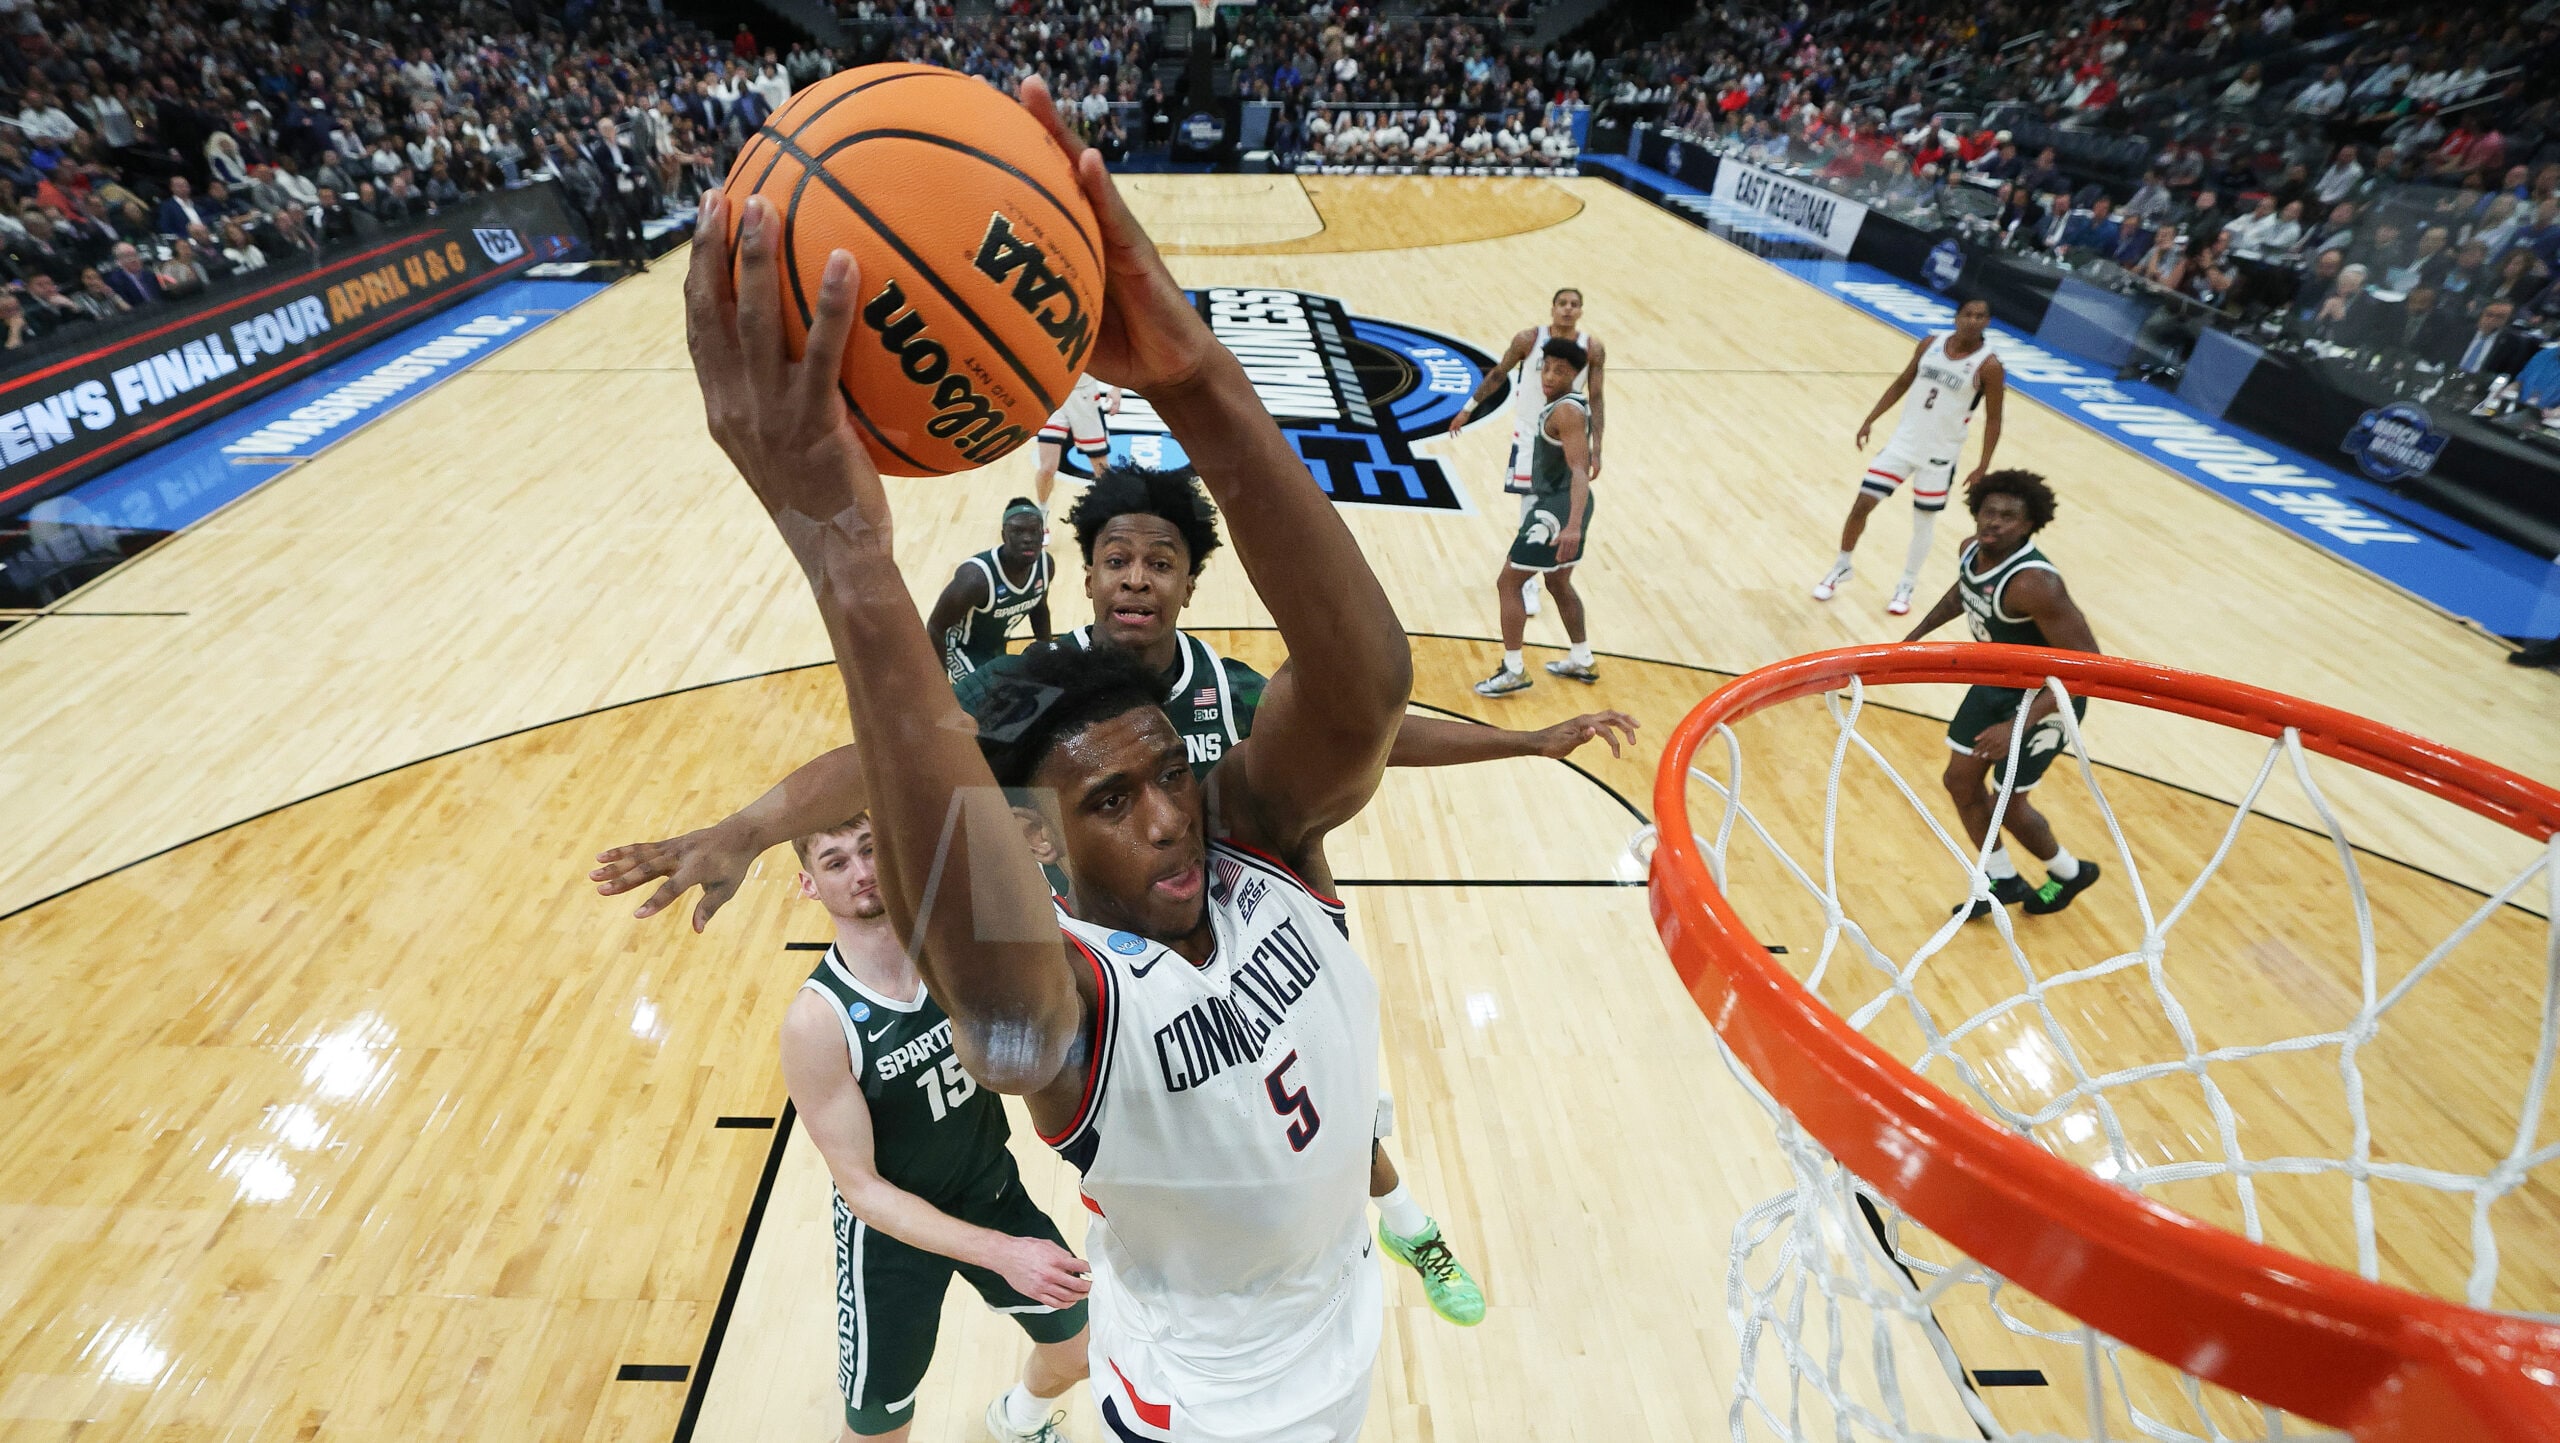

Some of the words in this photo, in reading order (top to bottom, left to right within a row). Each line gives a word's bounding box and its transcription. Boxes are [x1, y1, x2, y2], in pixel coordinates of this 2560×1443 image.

[1736, 172, 1770, 209] EAST
[1766, 182, 1837, 238] REGIONAL
[974, 210, 1093, 373] NCAA
[0, 379, 116, 470] EN'S
[111, 332, 238, 416] FINAL
[230, 294, 331, 367] FOUR
[325, 263, 410, 325] APRIL
[404, 254, 428, 288] 4
[424, 249, 449, 282] &
[445, 240, 466, 274] 6
[863, 278, 1031, 465] Wilson
[964, 357, 992, 385] NXT
[1208, 288, 1342, 420] MADNESS
[1423, 358, 1472, 395] ELITE
[221, 335, 490, 454] WASHINGTON
[1924, 387, 1939, 409] 2
[2079, 401, 2337, 489] ROAD
[2249, 489, 2421, 545] THE
[1235, 876, 1256, 910] BIG
[1241, 878, 1267, 921] EAST
[1153, 916, 1321, 1093] CONNECTICUT
[916, 1053, 977, 1123] 15
[1264, 1049, 1320, 1153] 5
